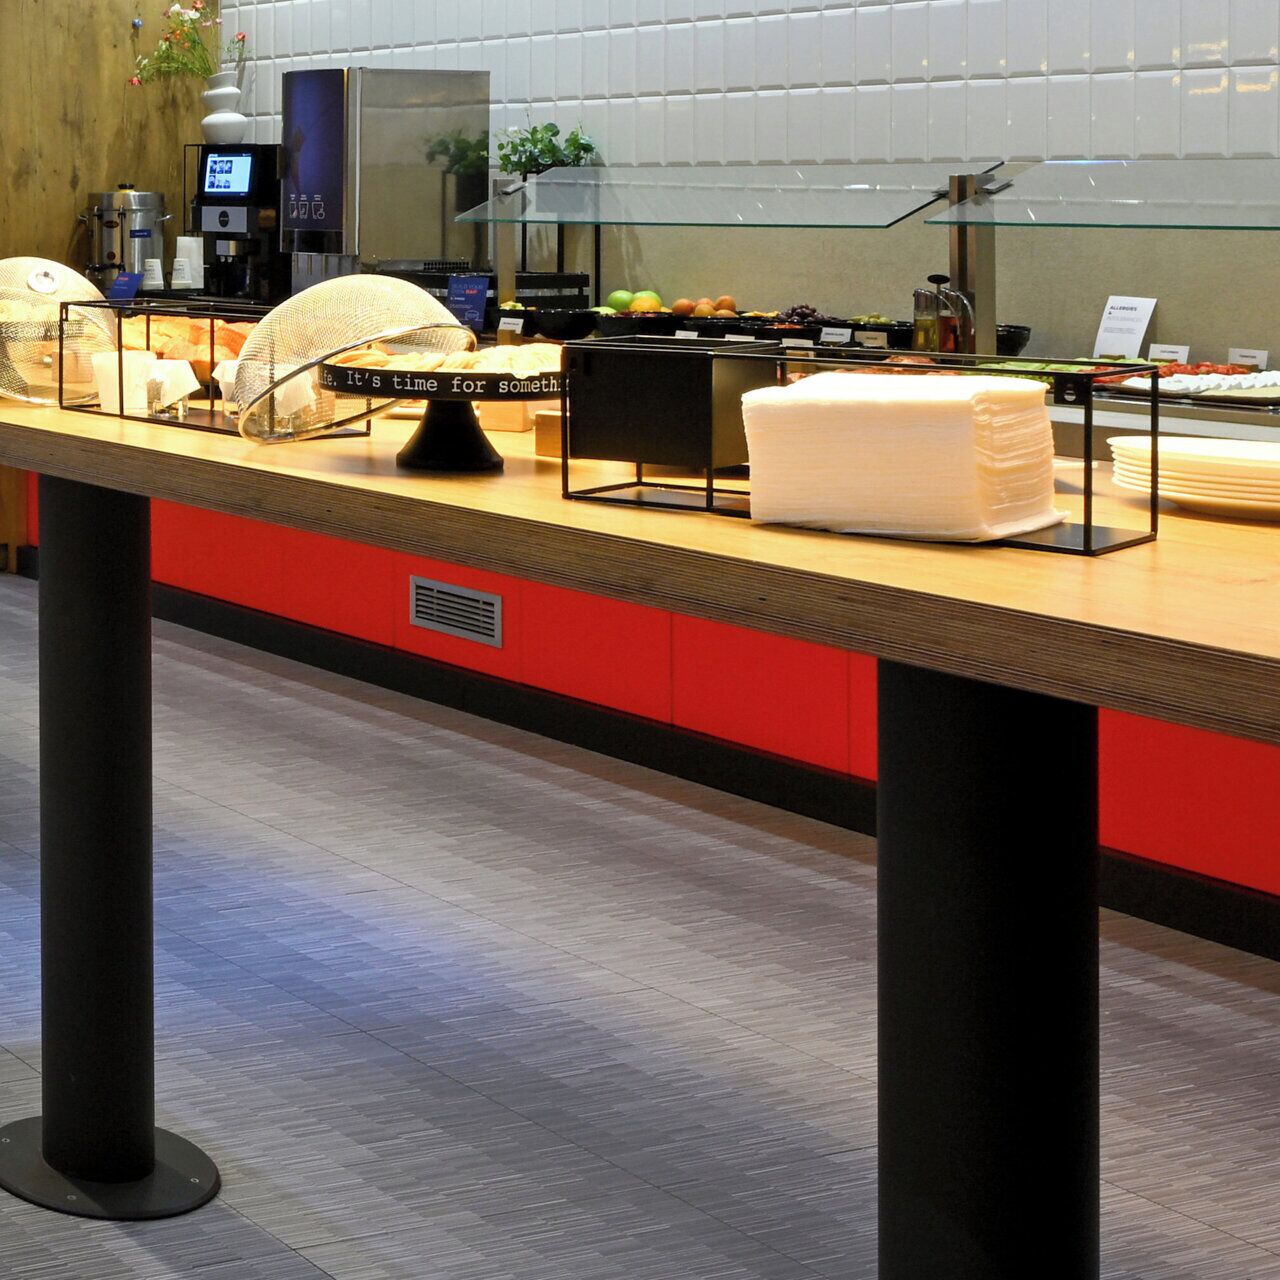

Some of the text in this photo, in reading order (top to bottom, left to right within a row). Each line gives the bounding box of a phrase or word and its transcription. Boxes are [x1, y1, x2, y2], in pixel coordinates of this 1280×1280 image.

[347, 370, 381, 388] It's
[392, 373, 438, 391] time
[451, 376, 486, 393] for
